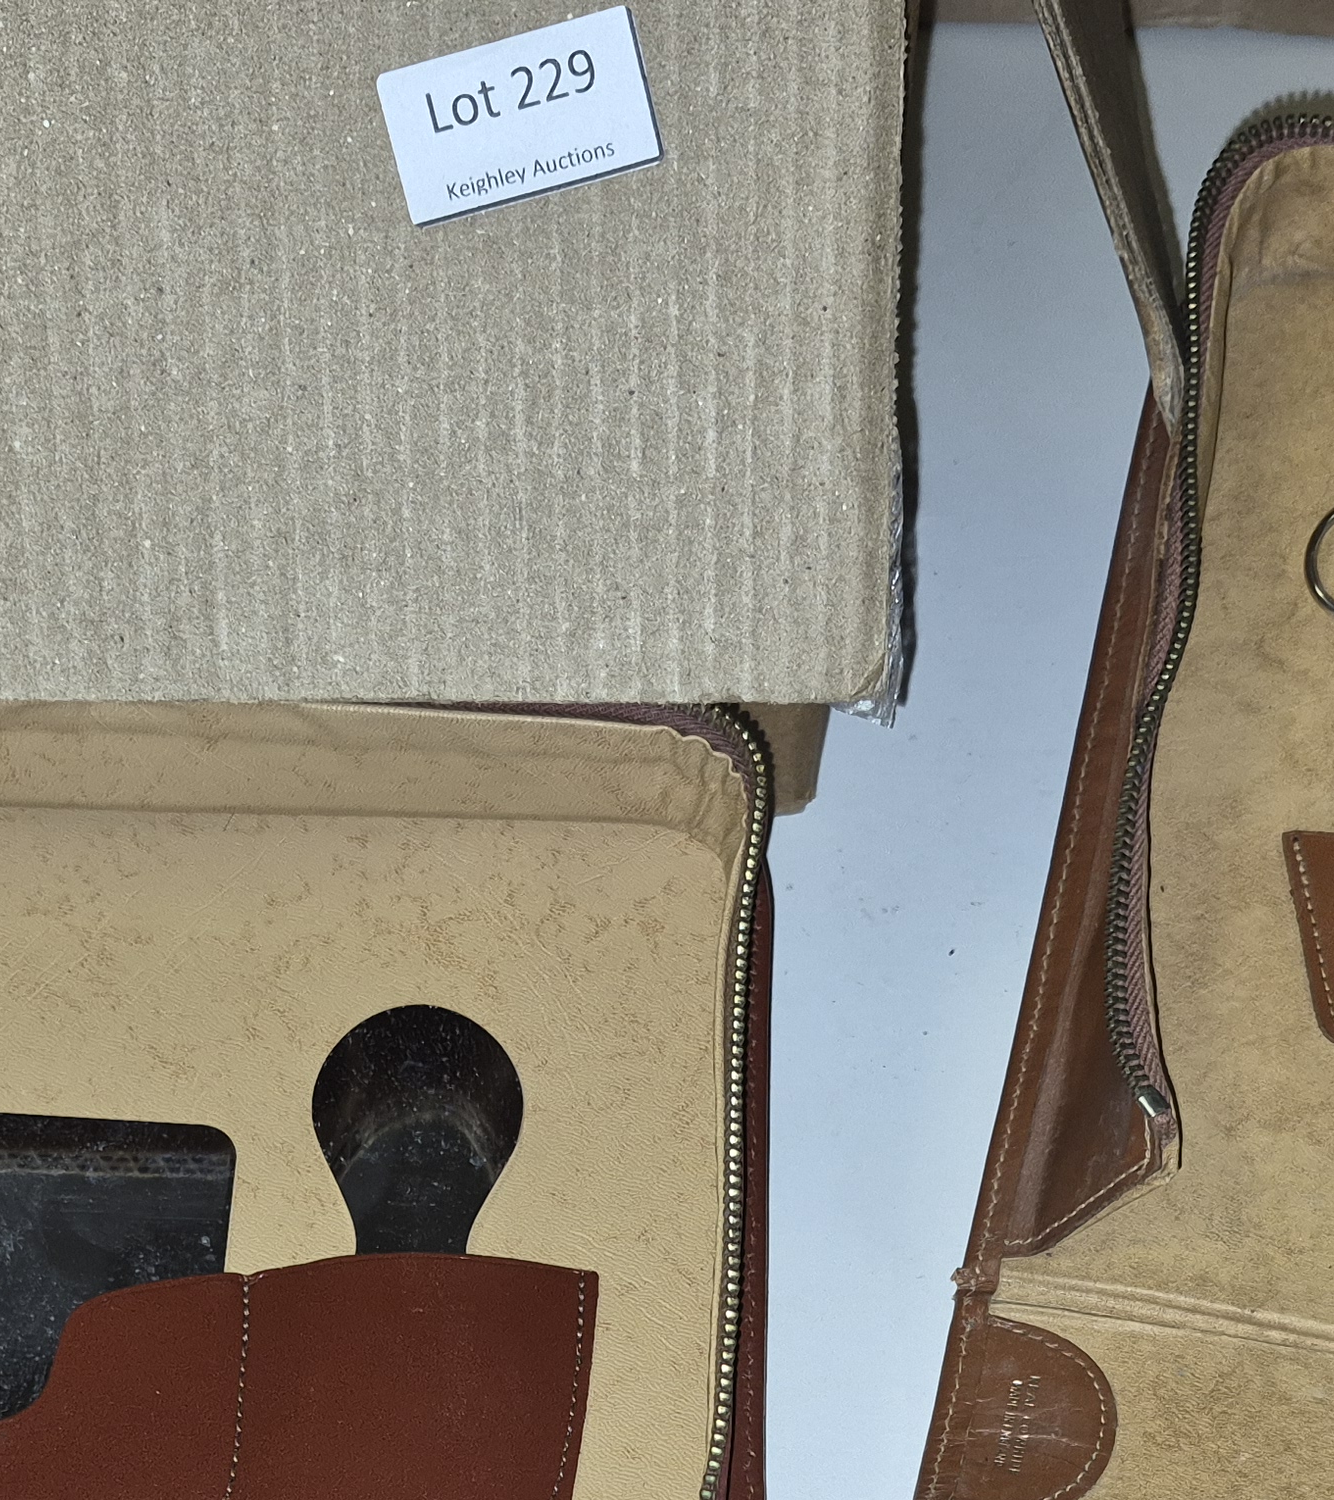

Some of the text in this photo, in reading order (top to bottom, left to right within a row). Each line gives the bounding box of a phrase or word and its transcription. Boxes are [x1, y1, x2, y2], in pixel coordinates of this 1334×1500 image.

[424, 48, 597, 134] Lot 229
[445, 141, 616, 202] Keighley Auctions
